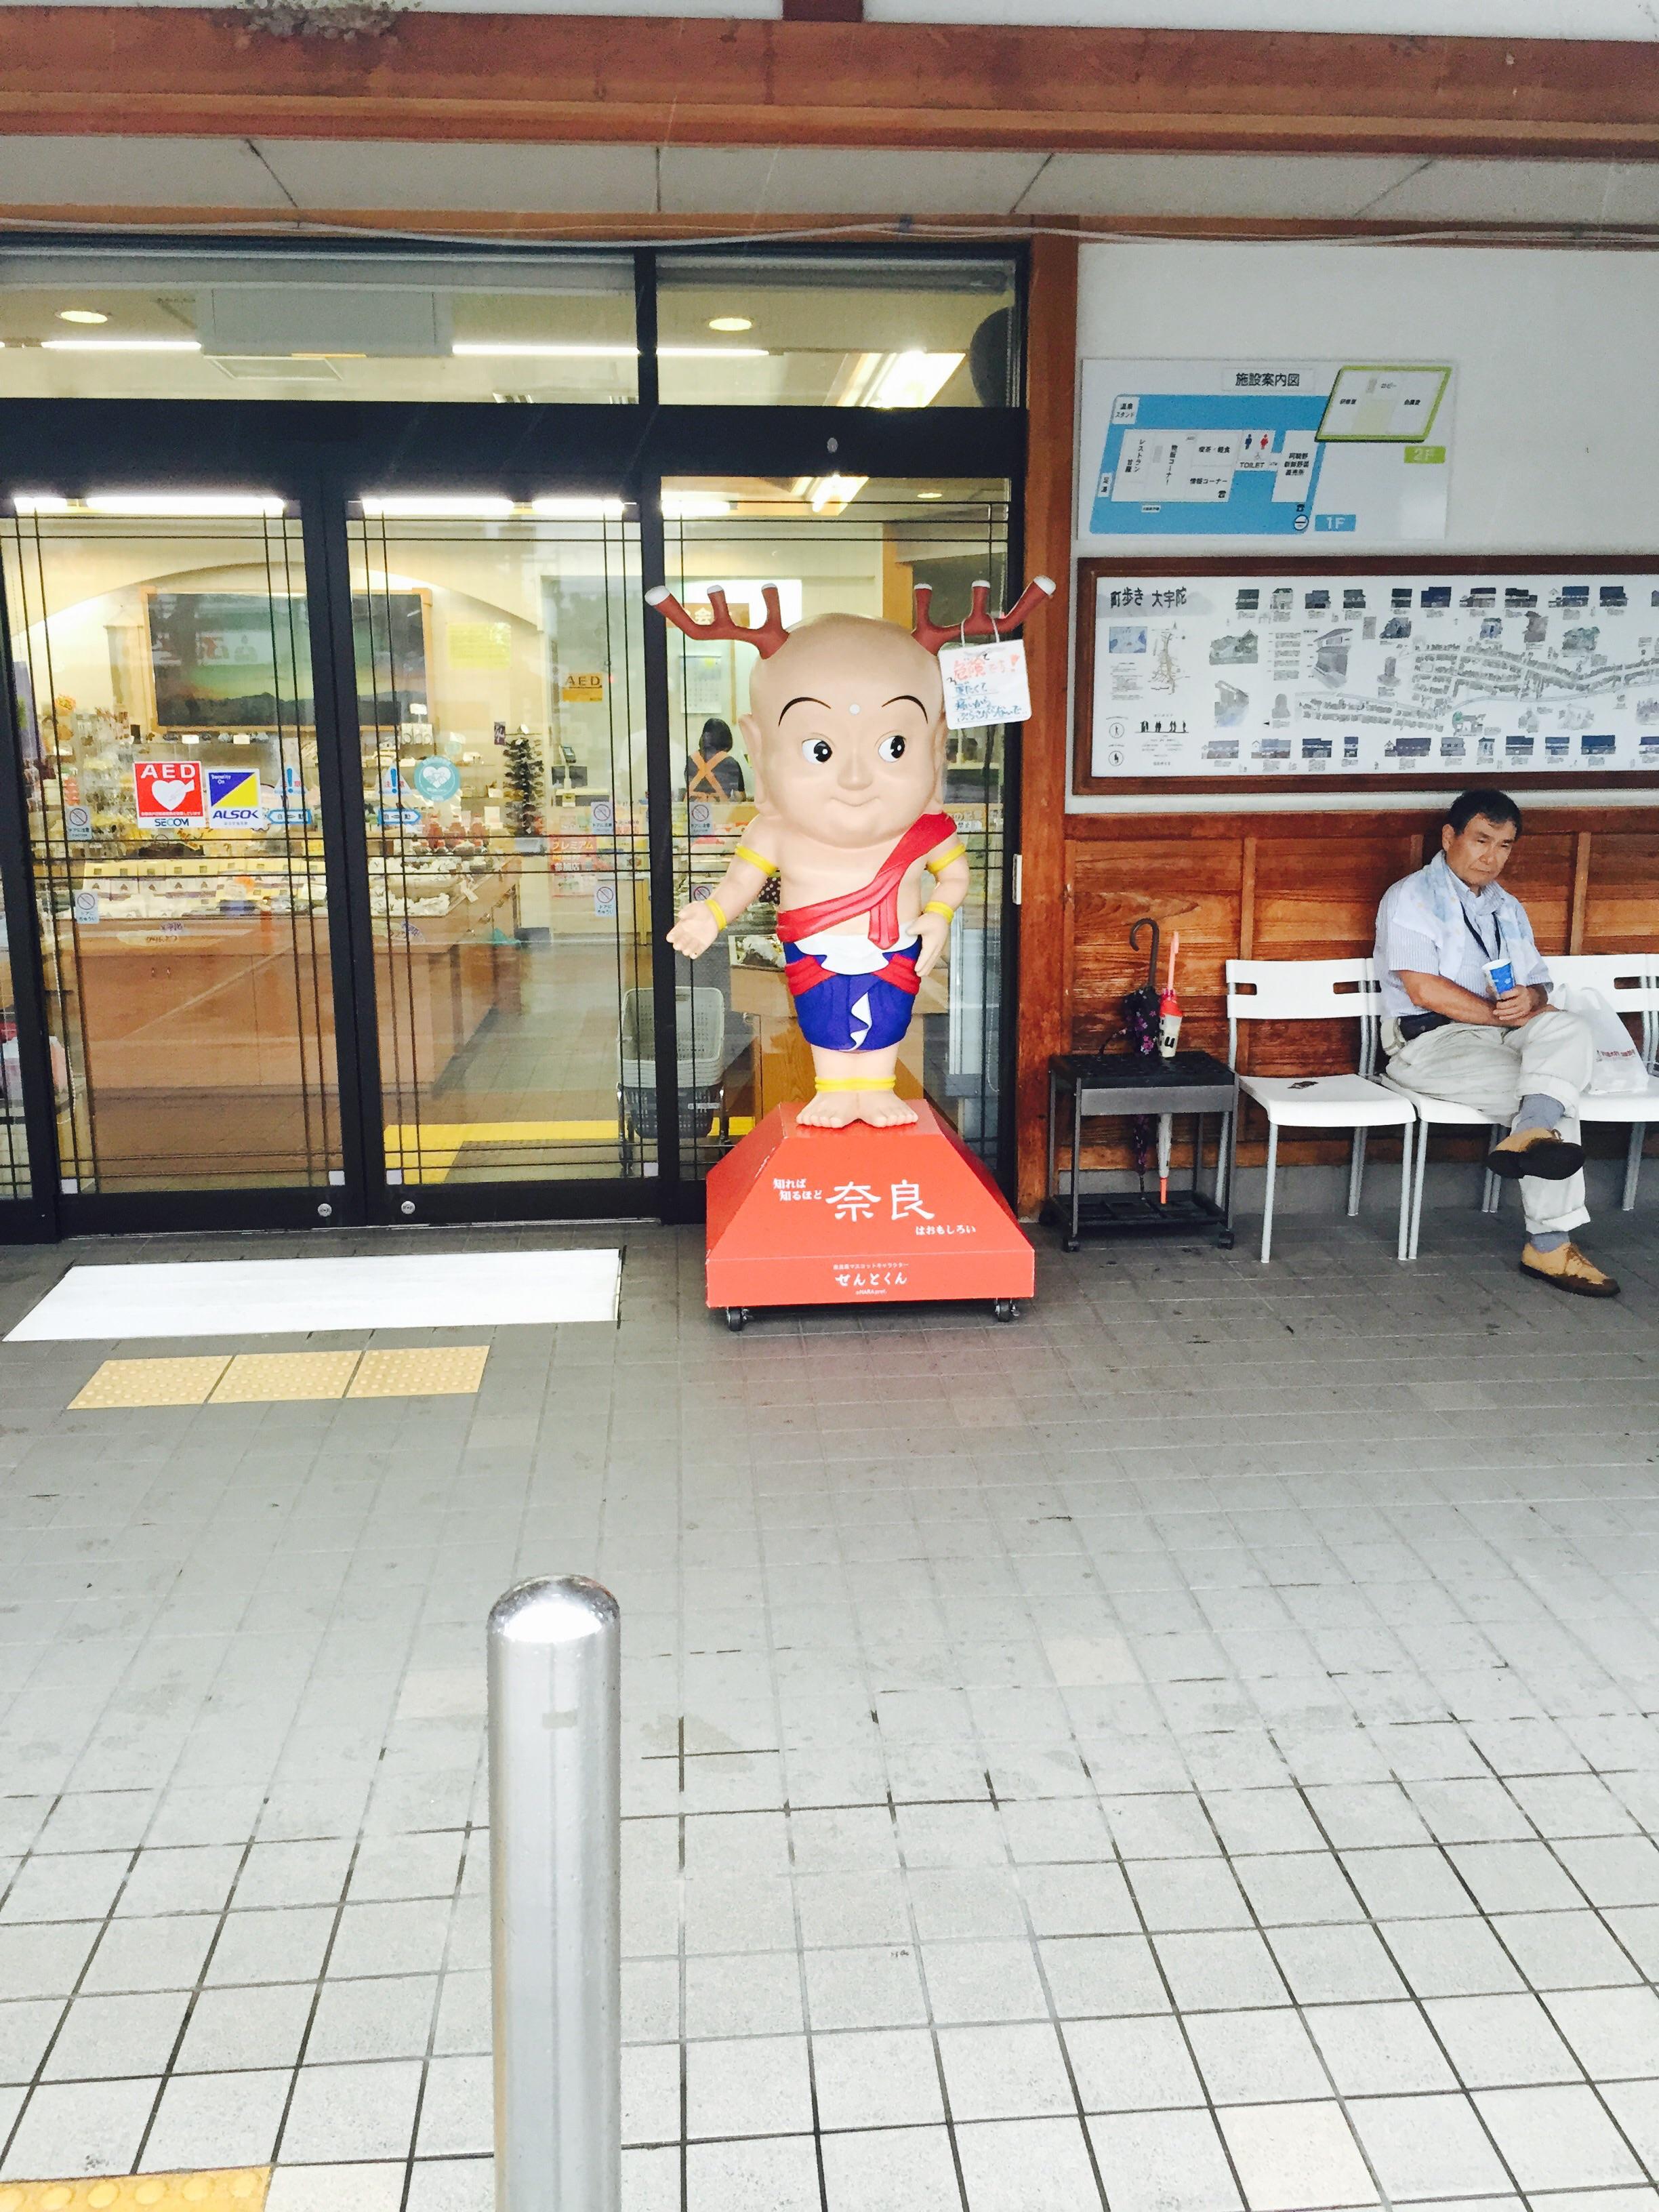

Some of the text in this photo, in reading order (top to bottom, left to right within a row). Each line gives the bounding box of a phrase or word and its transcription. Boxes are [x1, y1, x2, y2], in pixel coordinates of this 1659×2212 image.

[1235, 373, 1300, 387] 施設案内図
[1133, 438, 1146, 473] レストラン
[1413, 449, 1432, 461] 2F
[1326, 517, 1346, 529] 1F
[1111, 586, 1187, 608] 町歩き 大宇陀
[566, 676, 601, 686] AED
[140, 764, 196, 779] AED
[212, 810, 259, 819] ALSOK
[155, 818, 189, 827] SECOM
[773, 1178, 807, 1189] 知れば
[779, 1190, 822, 1202] 知るほど
[825, 1179, 935, 1222] 奈良
[916, 1225, 977, 1236] はおもしろい
[834, 1272, 908, 1287] せんとくん
